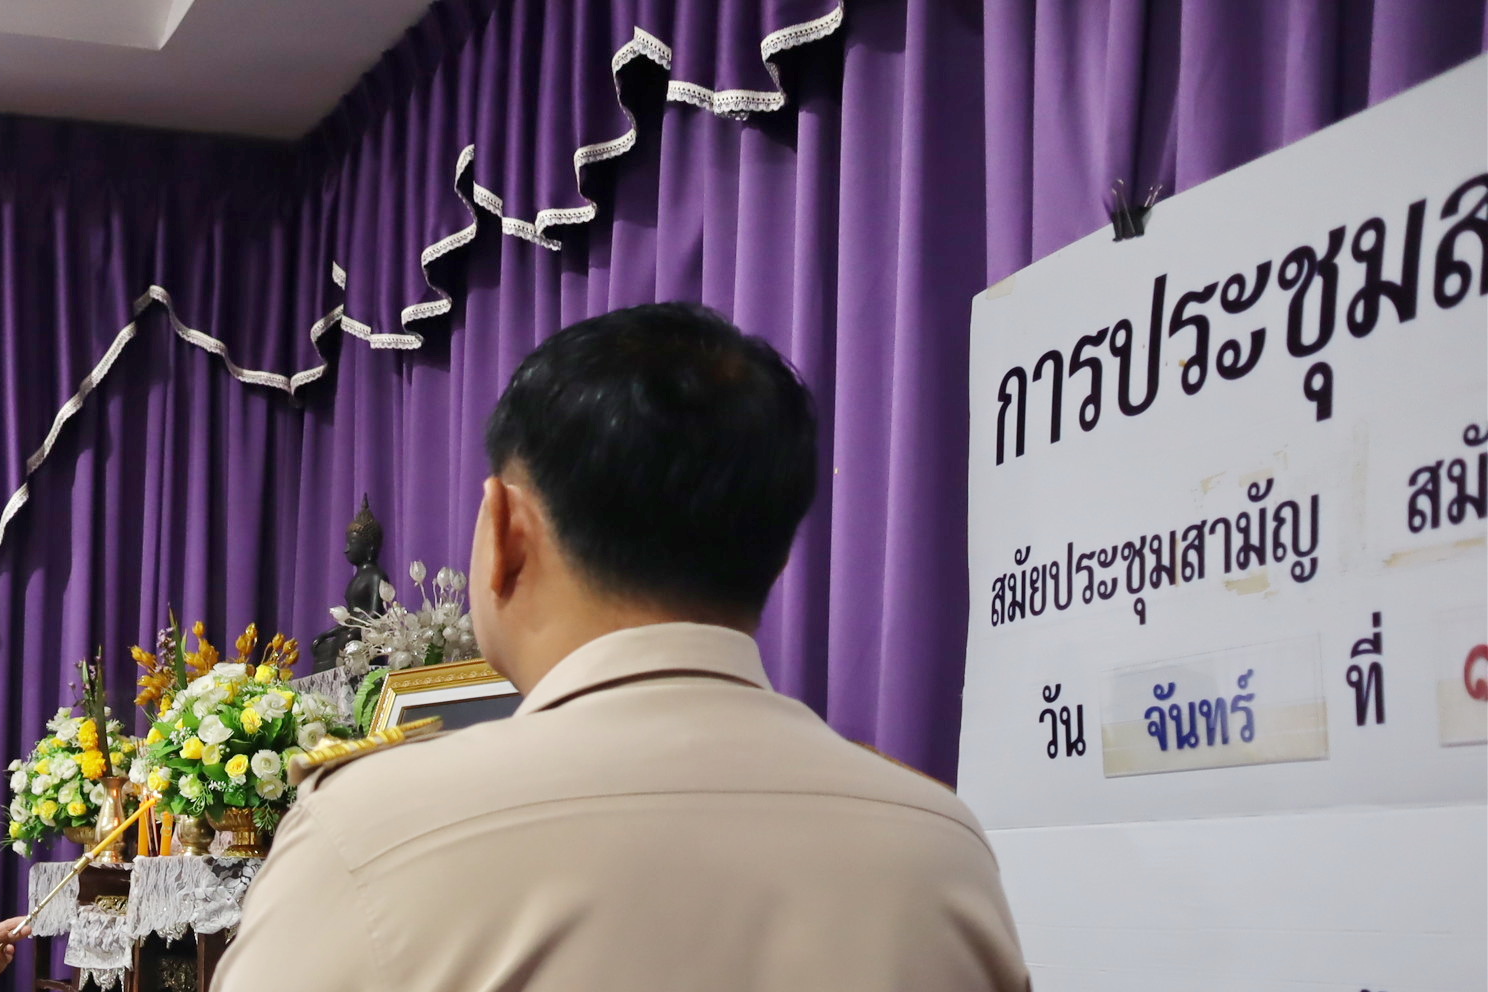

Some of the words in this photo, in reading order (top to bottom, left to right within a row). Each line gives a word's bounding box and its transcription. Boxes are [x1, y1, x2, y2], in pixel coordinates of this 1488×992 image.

[990, 477, 1321, 627] สมัยประชุมสามัญ
[1038, 683, 1087, 761] วัน
[1143, 668, 1256, 752] จันทร์
[1345, 611, 1387, 727] ที่
